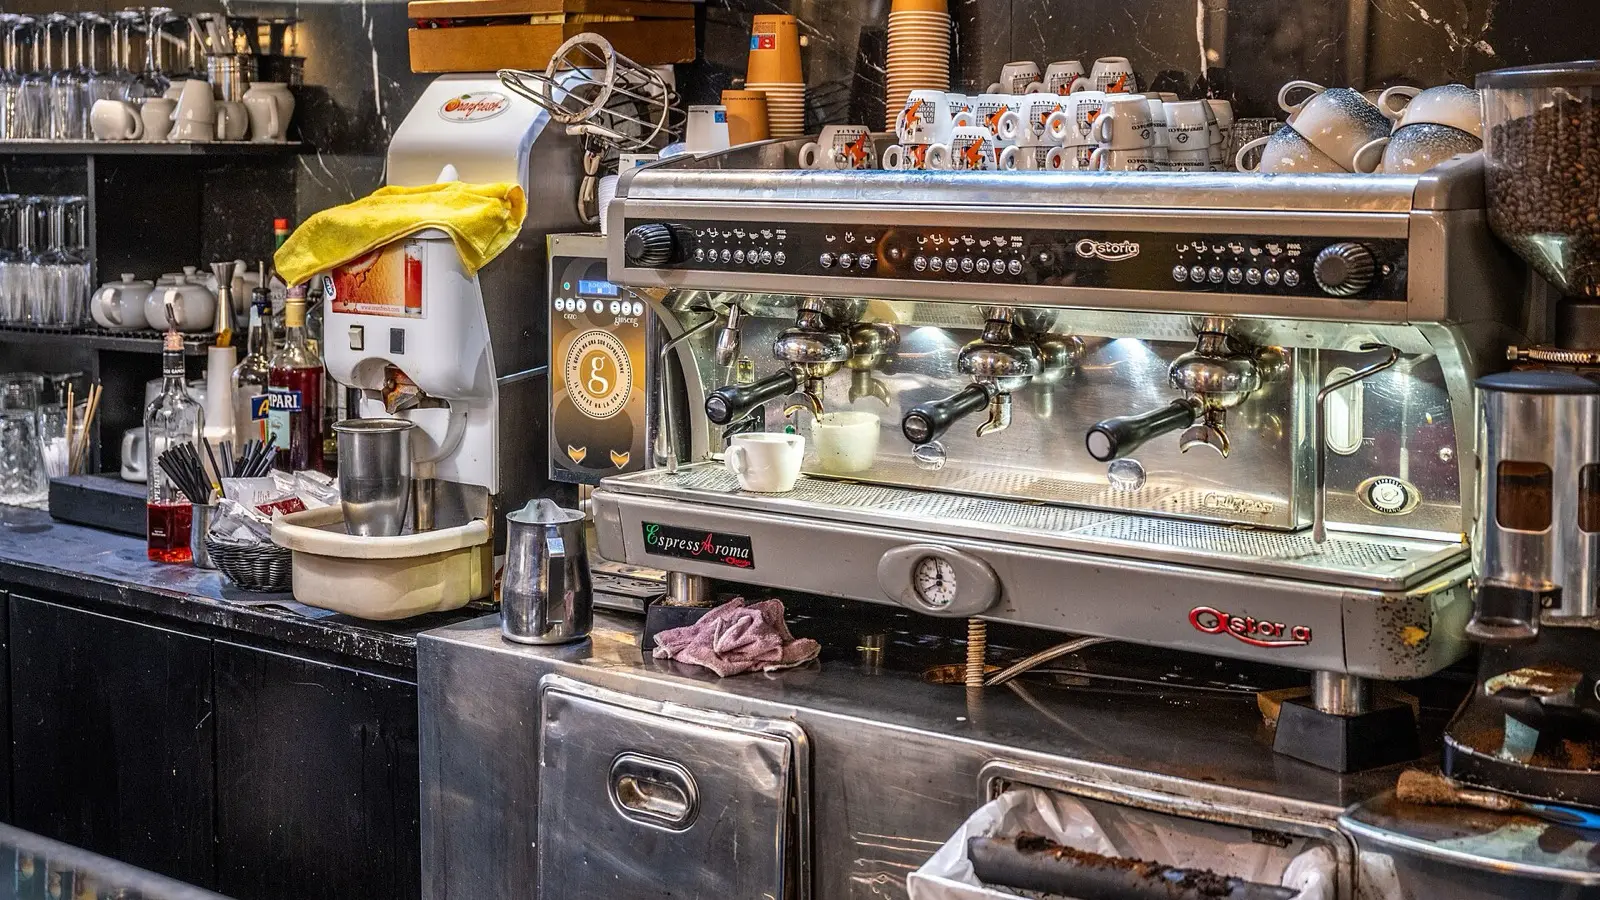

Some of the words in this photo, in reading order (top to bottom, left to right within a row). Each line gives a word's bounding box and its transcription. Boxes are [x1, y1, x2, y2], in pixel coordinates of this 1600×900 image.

[613, 314, 639, 327] ginseng
[588, 356, 609, 394] g
[1374, 504, 1401, 514] ITALIANO
[646, 524, 749, 558] EspressAroma
